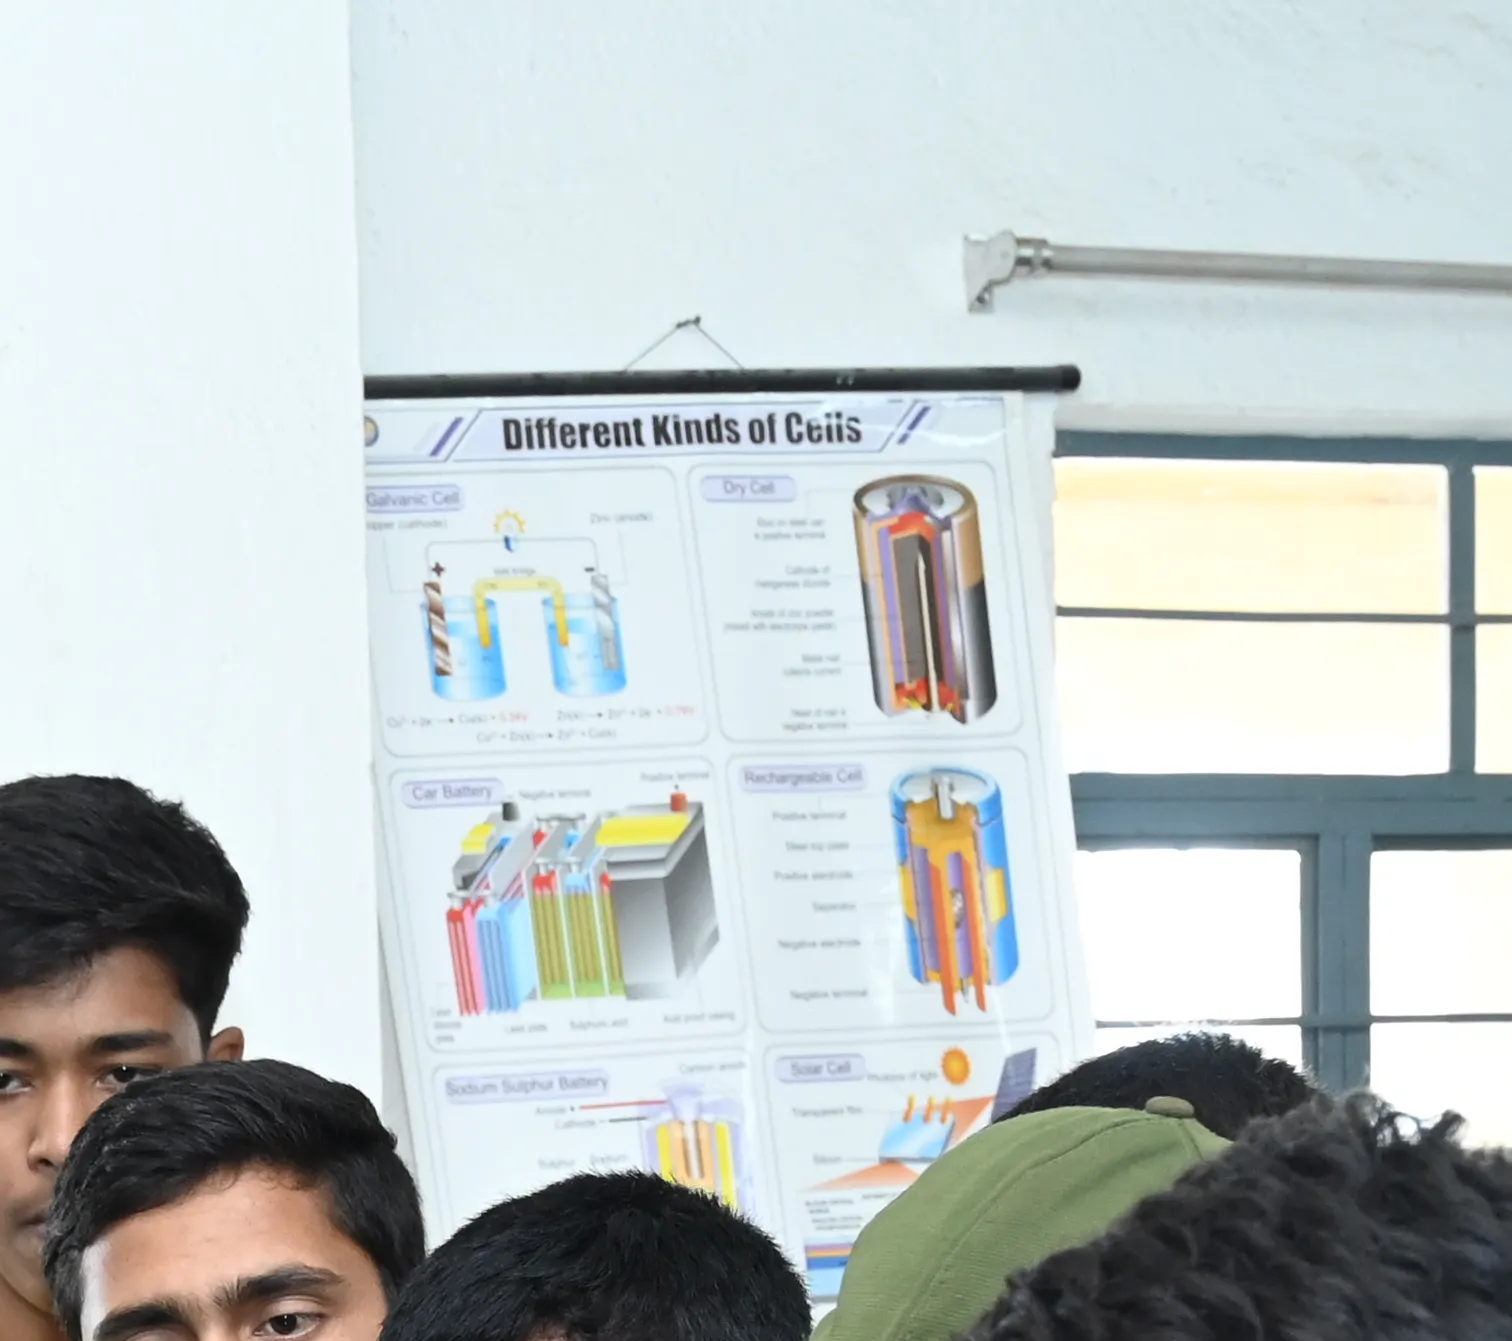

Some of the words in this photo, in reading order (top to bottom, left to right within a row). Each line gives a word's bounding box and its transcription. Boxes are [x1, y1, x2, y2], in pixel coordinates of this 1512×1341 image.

[502, 416, 645, 451] Different
[653, 413, 741, 448] Kinds
[748, 412, 777, 444] of
[432, 490, 460, 505] Cell
[722, 479, 745, 498] Dry
[750, 479, 775, 495] Cell
[744, 769, 833, 788] Rechargeable
[836, 767, 863, 784] Cell
[412, 784, 437, 802] Car
[442, 782, 492, 802] Battery
[790, 1061, 823, 1077] Solar
[826, 1060, 852, 1075] Cell
[445, 1079, 497, 1097] Sodium
[502, 1077, 555, 1096] Sulphur
[559, 1073, 608, 1093] Battery
